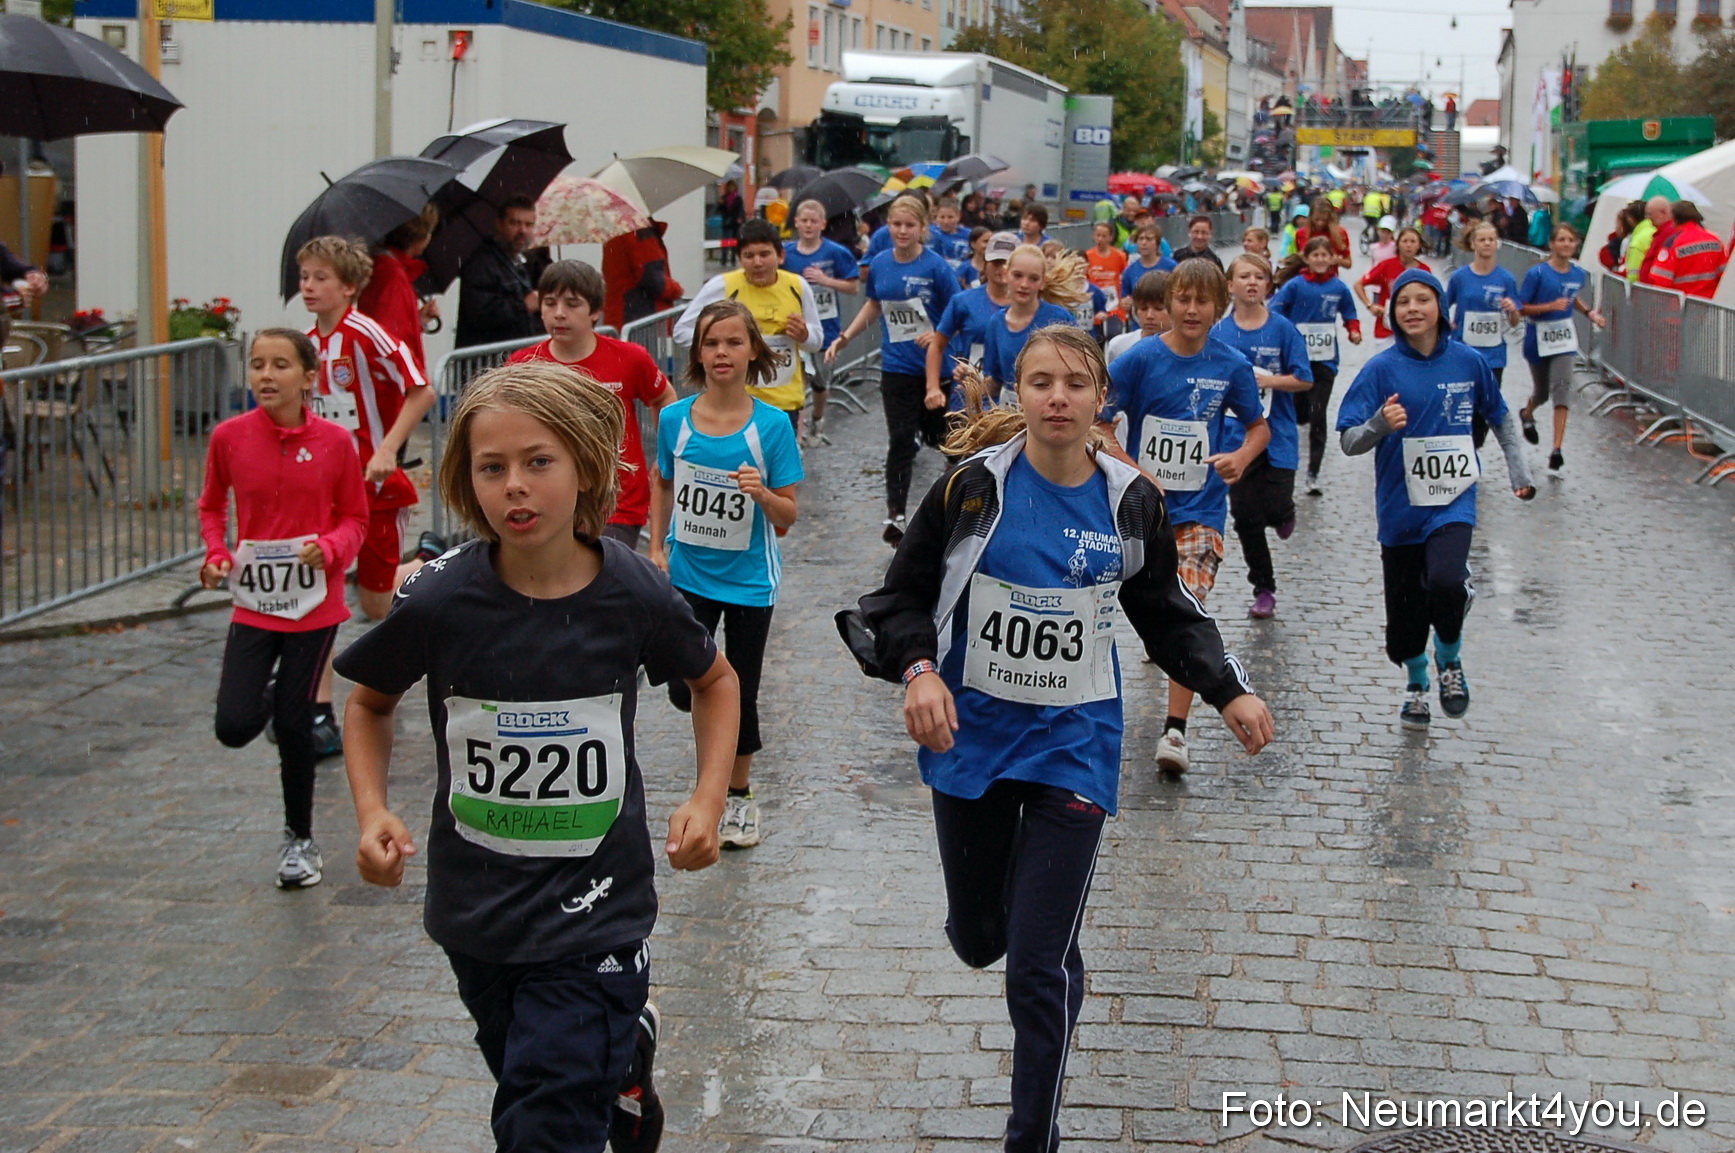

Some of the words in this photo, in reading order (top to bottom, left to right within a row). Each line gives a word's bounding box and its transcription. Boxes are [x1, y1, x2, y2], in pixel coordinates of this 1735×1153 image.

[1334, 132, 1376, 142] START
[1468, 321, 1498, 334] 4093
[1303, 333, 1332, 347] 050
[1145, 435, 1203, 466] 4014
[1156, 468, 1186, 481] Albert
[1411, 454, 1471, 480] 4042
[1428, 485, 1457, 496] Oliver
[676, 484, 747, 522] 4043
[683, 520, 728, 539] Hannah
[1063, 527, 1080, 539] 12.
[239, 562, 316, 594] 4070
[256, 599, 299, 613] Isabell
[1011, 590, 1063, 608] BOCK
[980, 610, 1084, 663] 4063
[987, 661, 1068, 690] Franziska
[497, 711, 570, 729] BOCK
[466, 738, 608, 800] 5220
[486, 808, 584, 836] RAPHAEL
[597, 964, 623, 974] adidas
